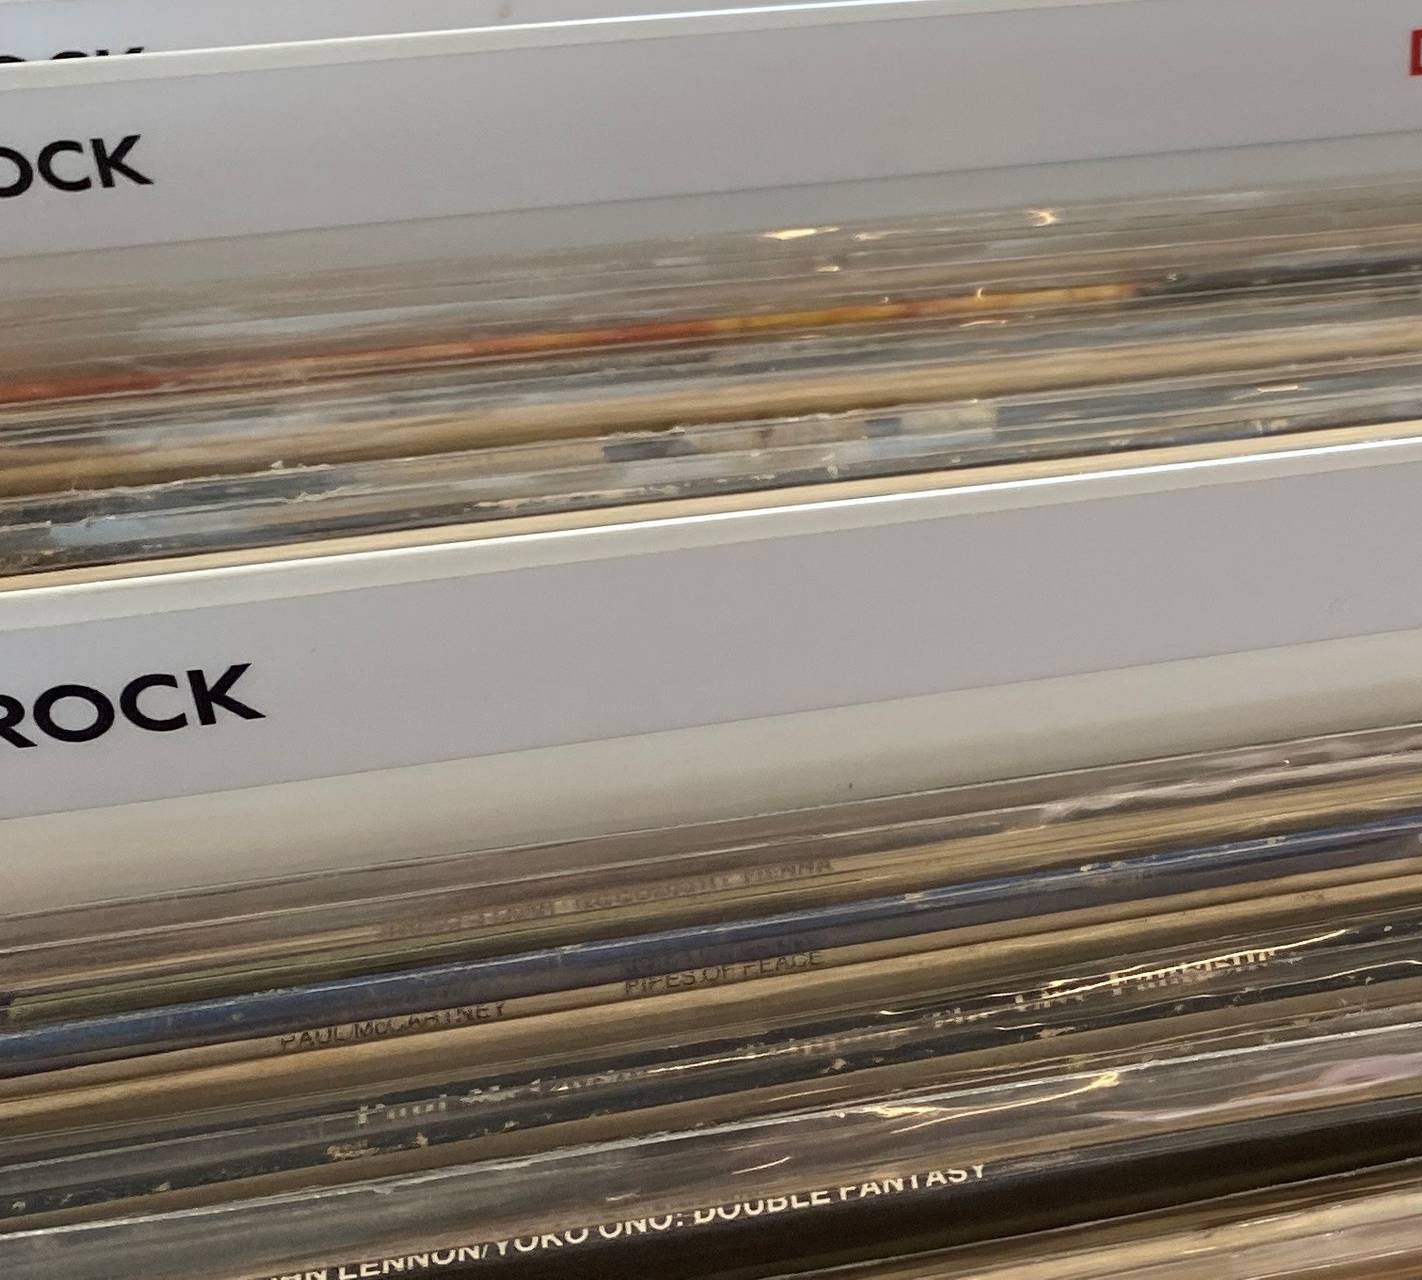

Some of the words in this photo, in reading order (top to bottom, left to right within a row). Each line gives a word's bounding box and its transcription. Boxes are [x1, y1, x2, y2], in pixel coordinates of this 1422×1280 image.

[0, 662, 267, 749] ROCK
[280, 1026, 347, 1051] PAUL
[624, 969, 696, 996] PIPES
[838, 1163, 986, 1201] FANTASY
